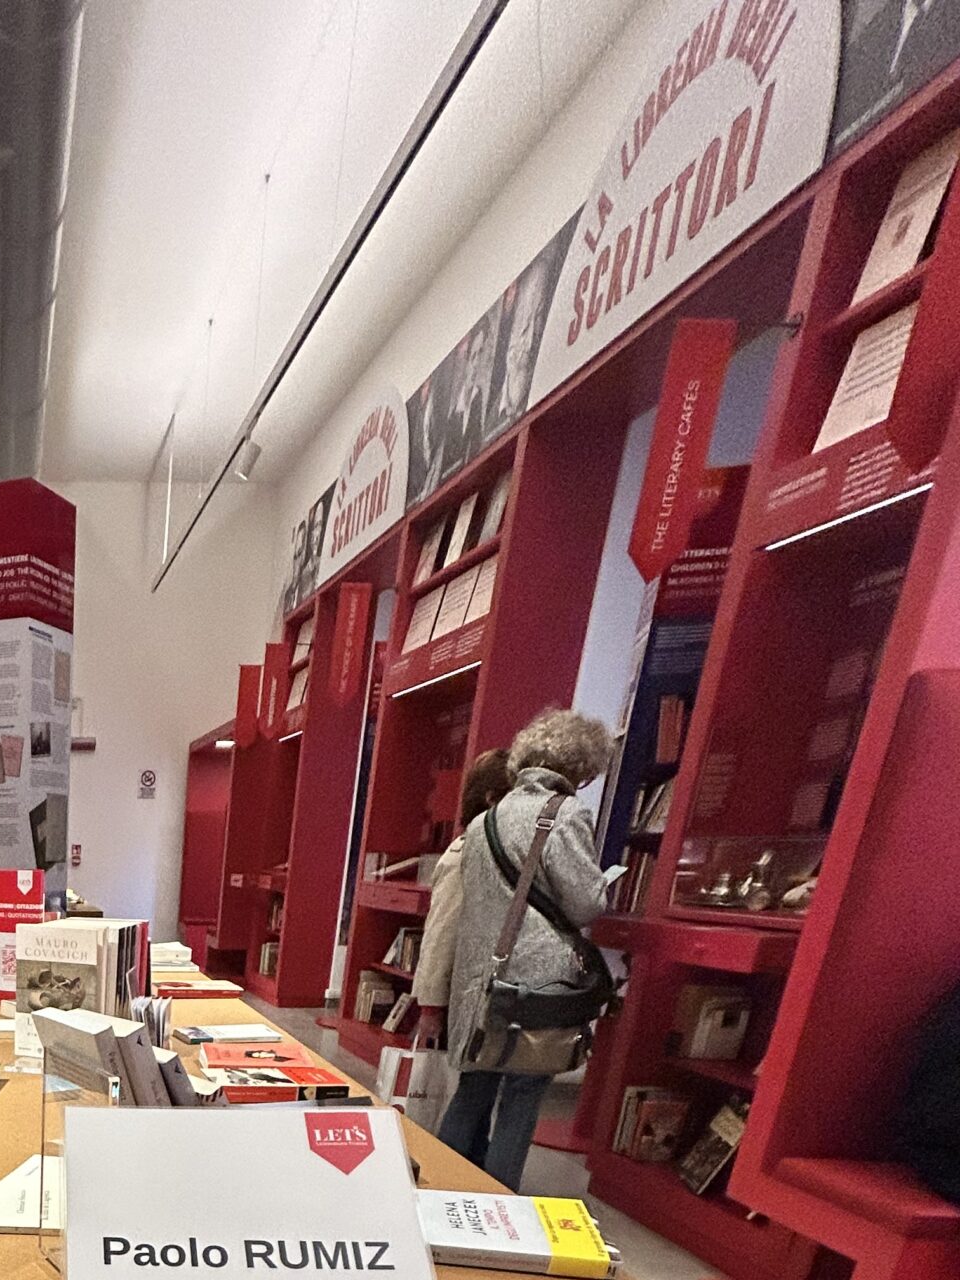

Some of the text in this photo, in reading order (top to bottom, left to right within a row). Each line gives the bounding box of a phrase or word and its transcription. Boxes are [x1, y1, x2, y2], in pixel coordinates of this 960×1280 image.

[567, 80, 776, 346] SCRITTORI
[659, 439, 686, 517] LITERARY
[651, 520, 669, 553] THE
[24, 948, 89, 961] COVACICH
[35, 937, 78, 949] MAURO
[444, 1202, 465, 1229] HELENA
[462, 1199, 487, 1236] JANECZEK
[102, 1236, 396, 1271] Paolo RUMIZ
